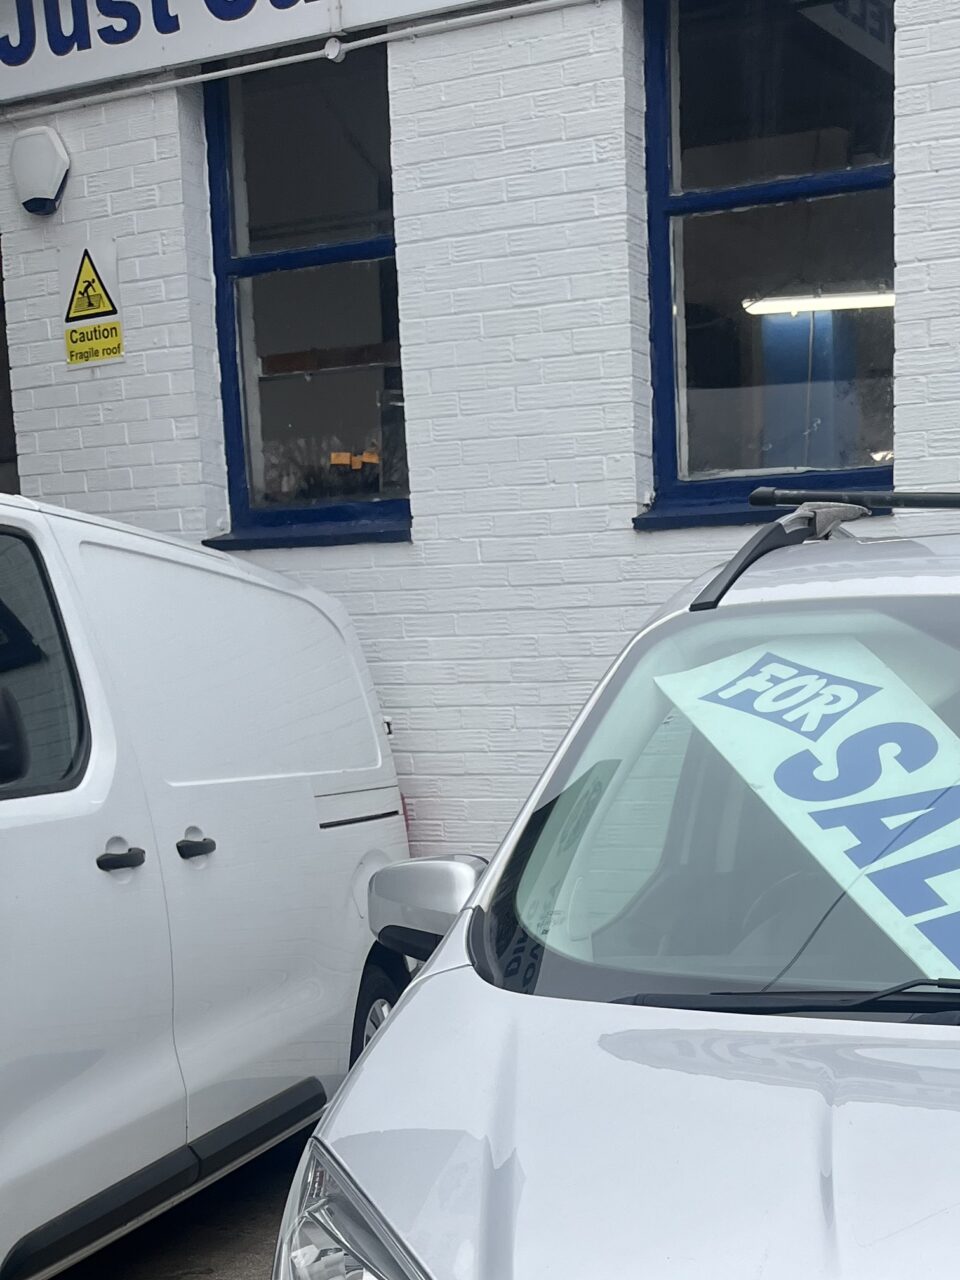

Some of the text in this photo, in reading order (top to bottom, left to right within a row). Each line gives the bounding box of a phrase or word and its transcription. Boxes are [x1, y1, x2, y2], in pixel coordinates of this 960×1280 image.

[69, 325, 118, 344] Caution
[69, 343, 121, 361] Fragile roof
[718, 662, 859, 733] FOR
